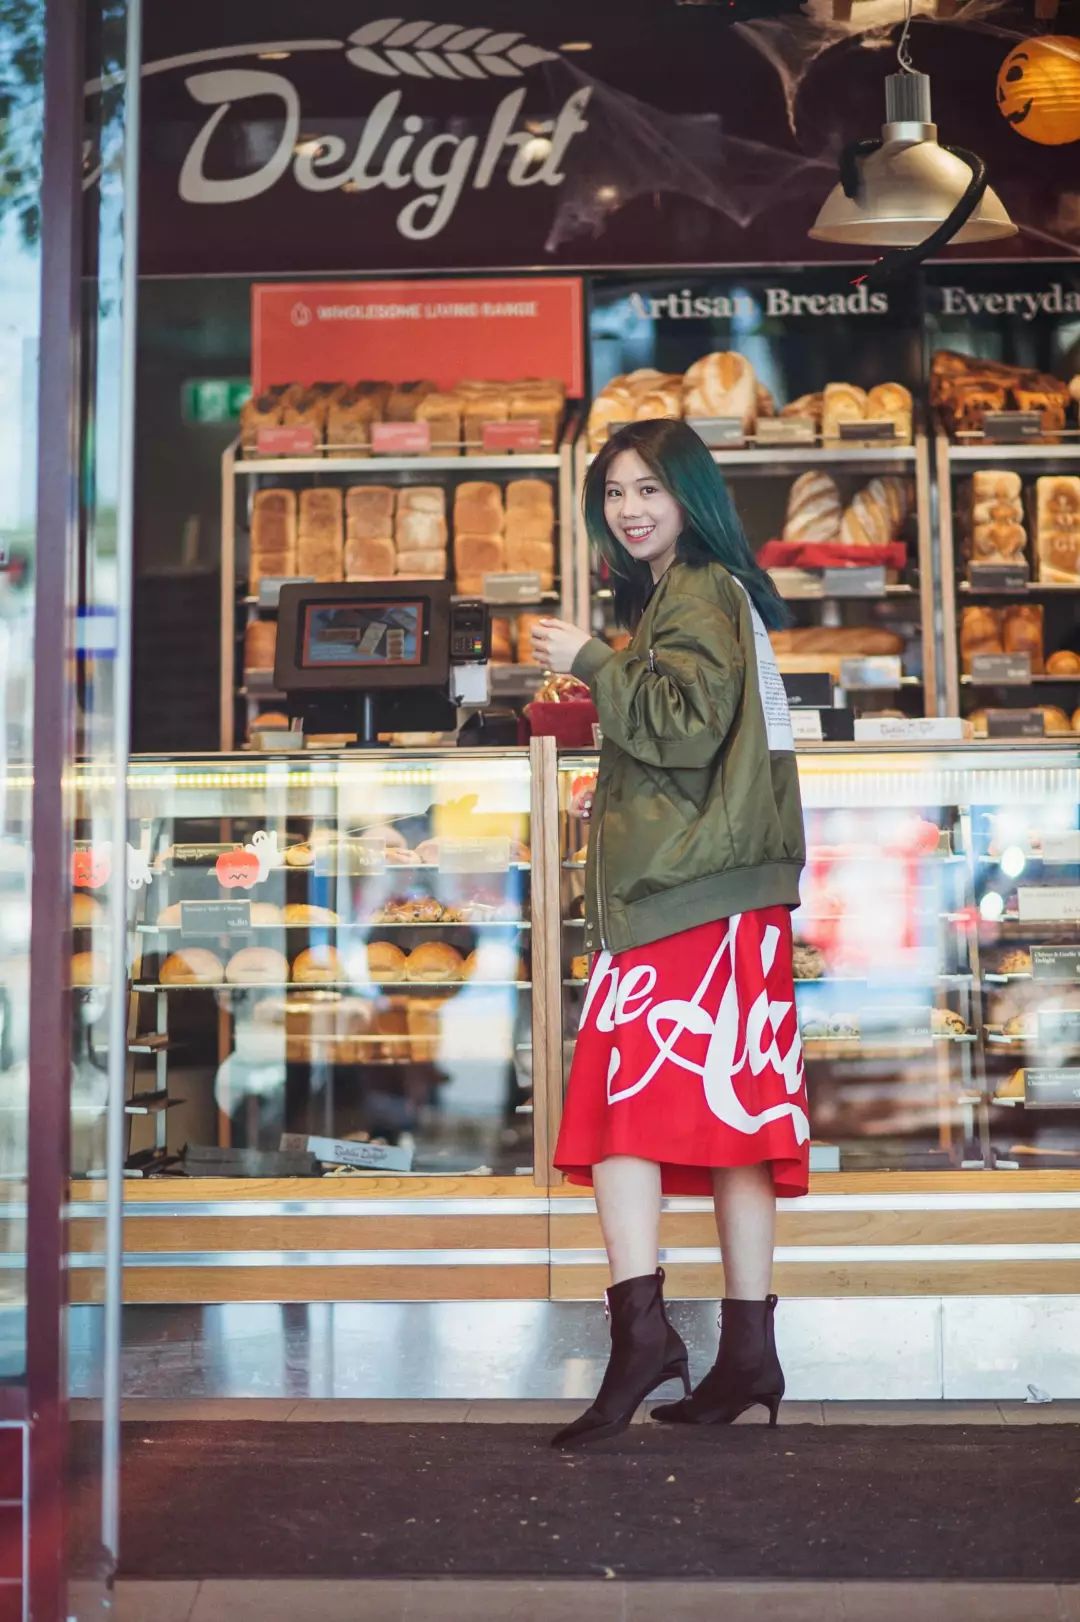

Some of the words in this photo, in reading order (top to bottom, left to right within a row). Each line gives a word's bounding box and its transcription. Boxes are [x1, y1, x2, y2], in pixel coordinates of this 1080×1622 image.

[178, 69, 593, 240] Delight
[628, 289, 754, 319] Artisan
[765, 285, 889, 316] Breads
